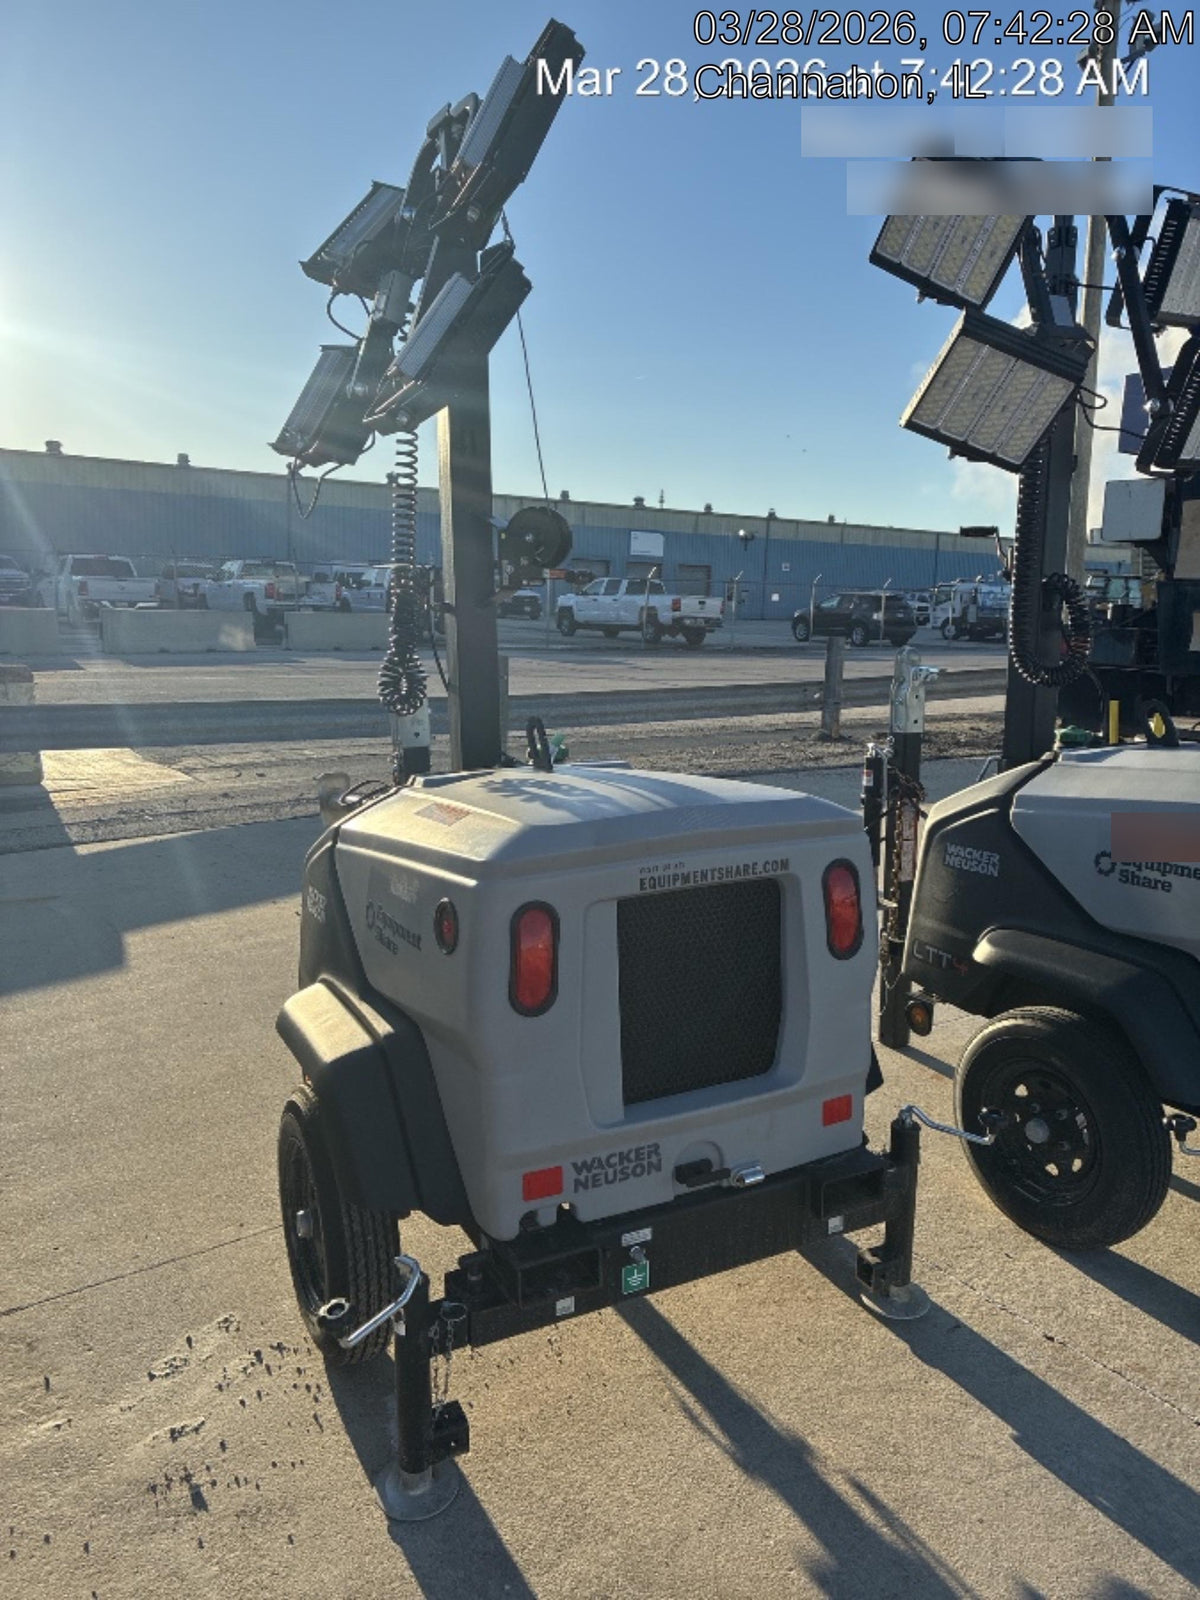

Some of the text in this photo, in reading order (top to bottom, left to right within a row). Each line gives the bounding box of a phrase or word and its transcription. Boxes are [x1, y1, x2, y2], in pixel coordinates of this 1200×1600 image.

[944, 854, 999, 877] NEUSON
[946, 842, 1001, 864] WACKER
[639, 857, 790, 891] EQUIPMENTSHARE.COM
[1118, 868, 1172, 893] Share
[1119, 861, 1200, 881] quipme
[570, 1142, 662, 1176] WACKER
[573, 1157, 662, 1194] NEUSON
